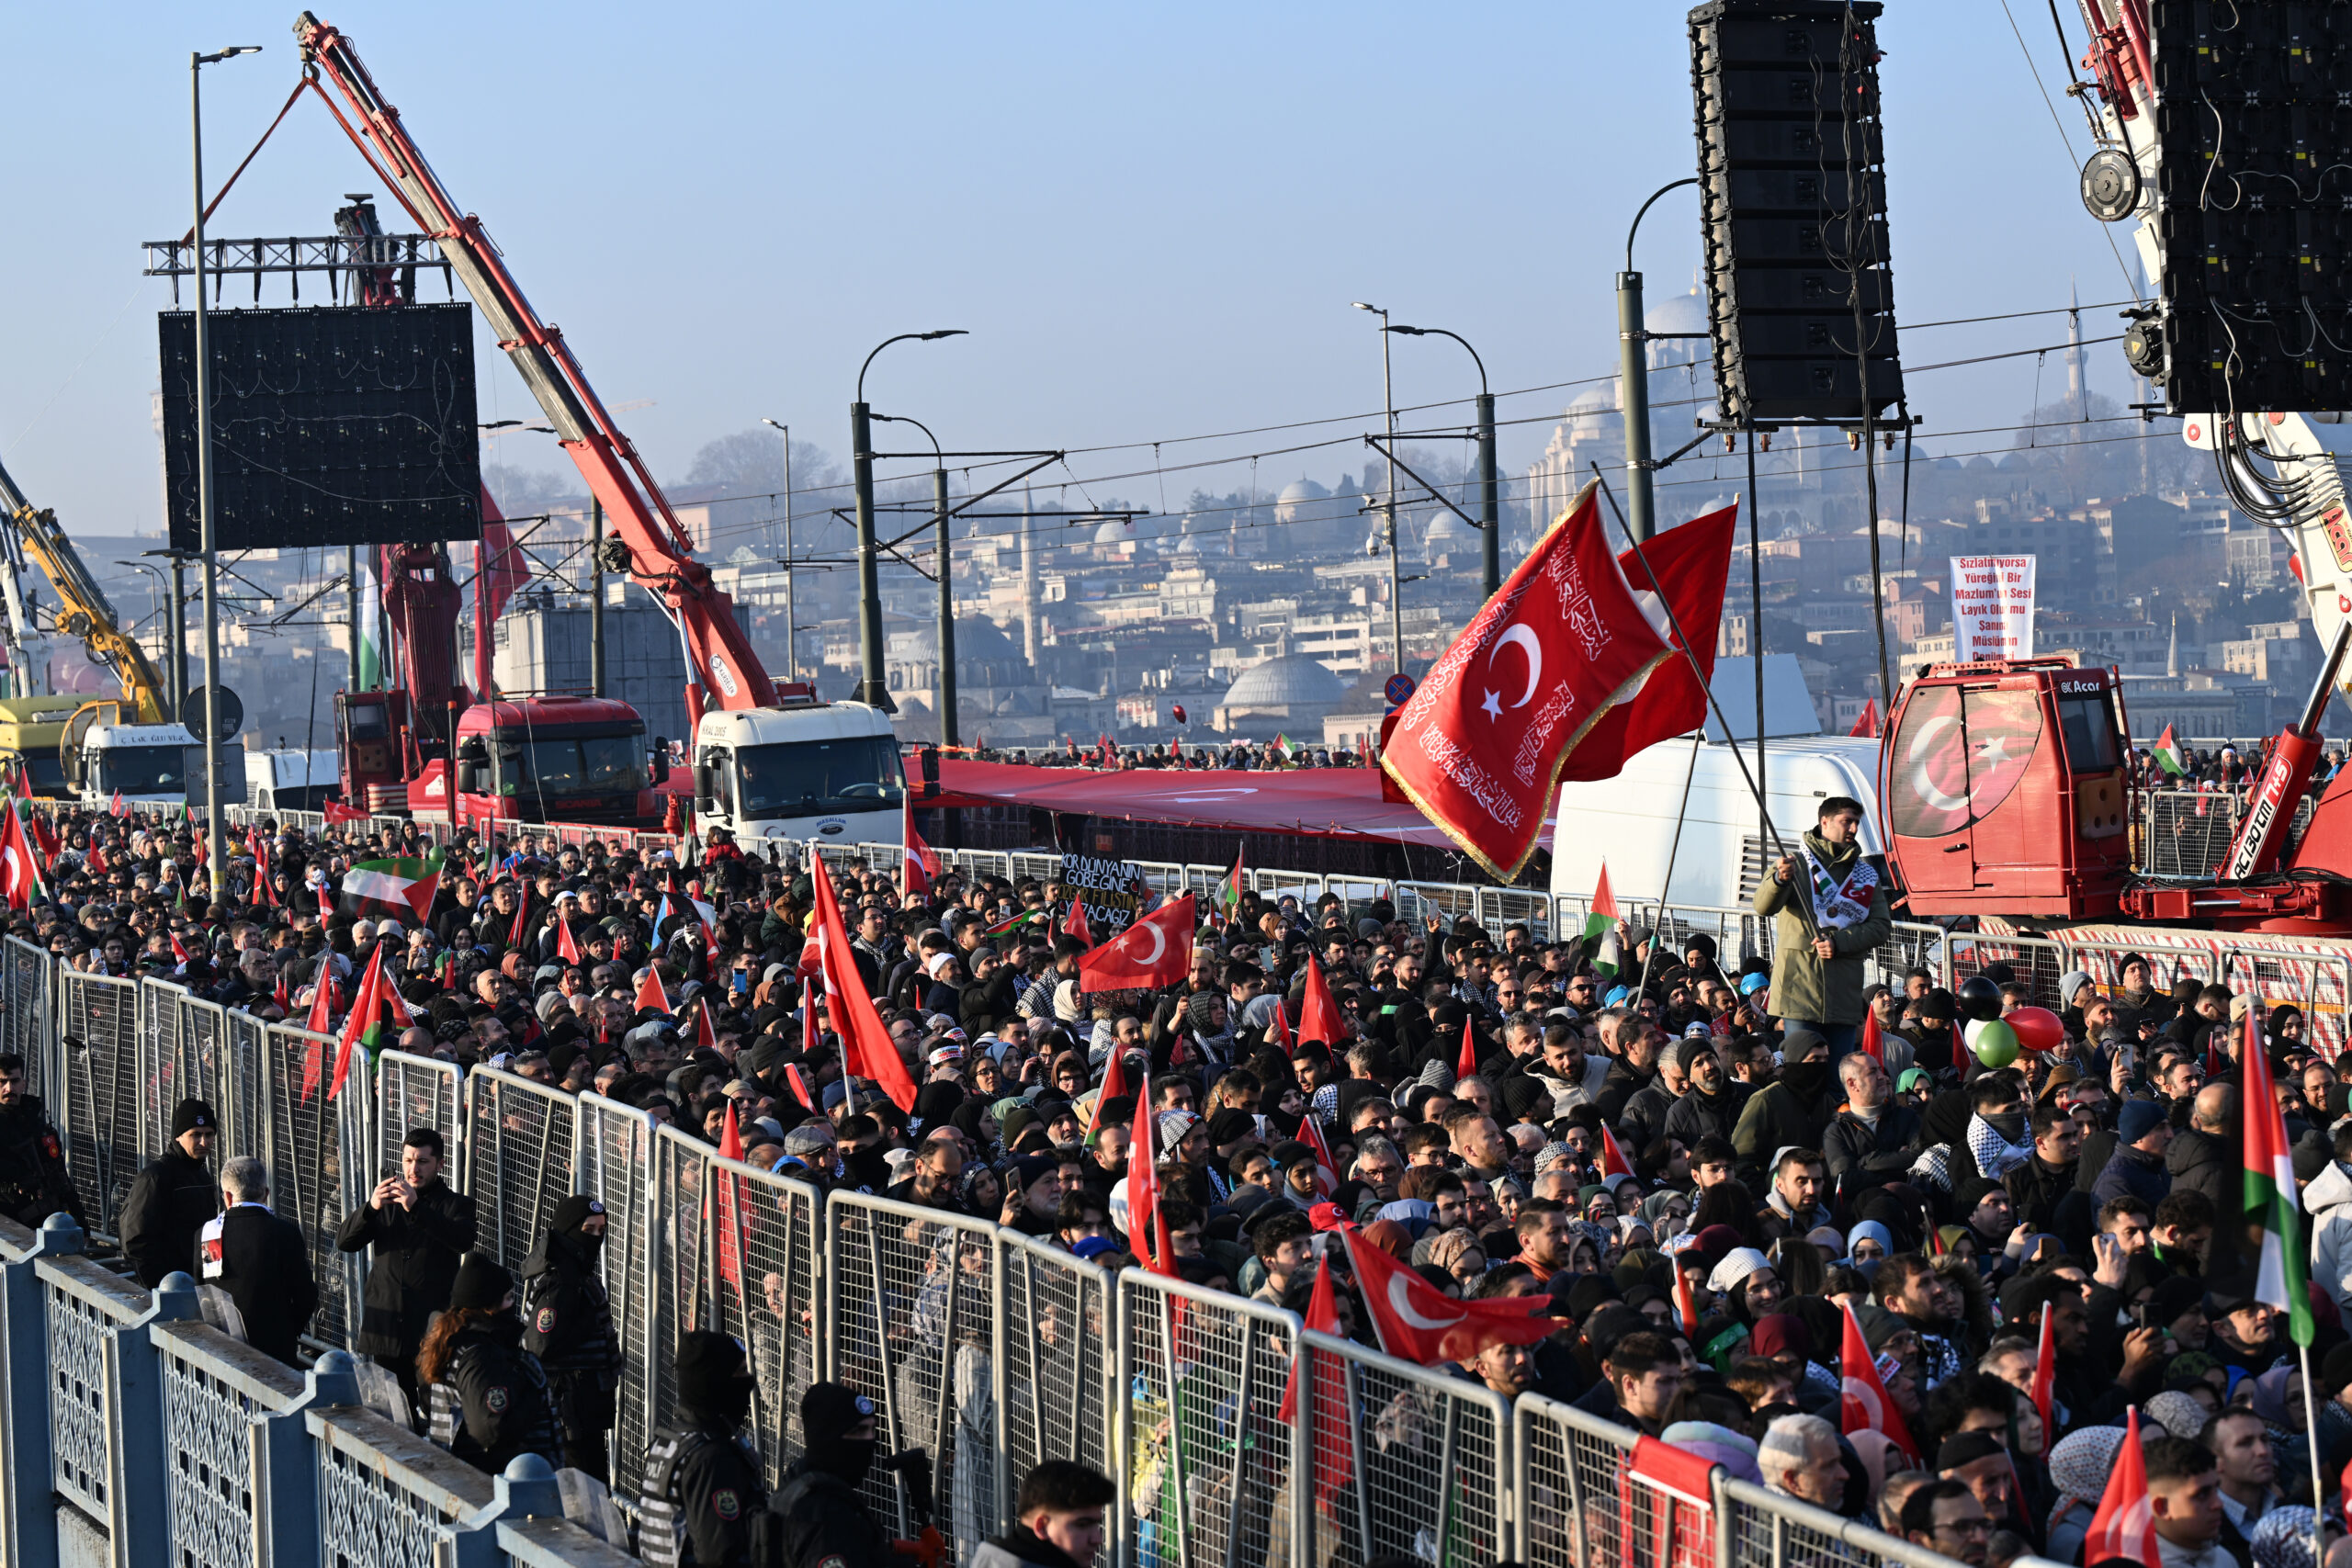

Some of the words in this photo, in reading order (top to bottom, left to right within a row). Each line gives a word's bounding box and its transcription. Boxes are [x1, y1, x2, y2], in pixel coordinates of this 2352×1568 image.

[2007, 572, 2021, 582] Bir
[2010, 588, 2031, 598] Sesi
[1962, 604, 1987, 616] Layık
[1990, 604, 2007, 615] Olu
[2010, 605, 2025, 615] mu
[1973, 651, 2014, 661] Denilmei
[718, 666, 735, 694] KARDELEN
[2074, 681, 2099, 693] Acar
[556, 799, 603, 809] SCANIA
[1065, 900, 1130, 927] YZACAĞIZ
